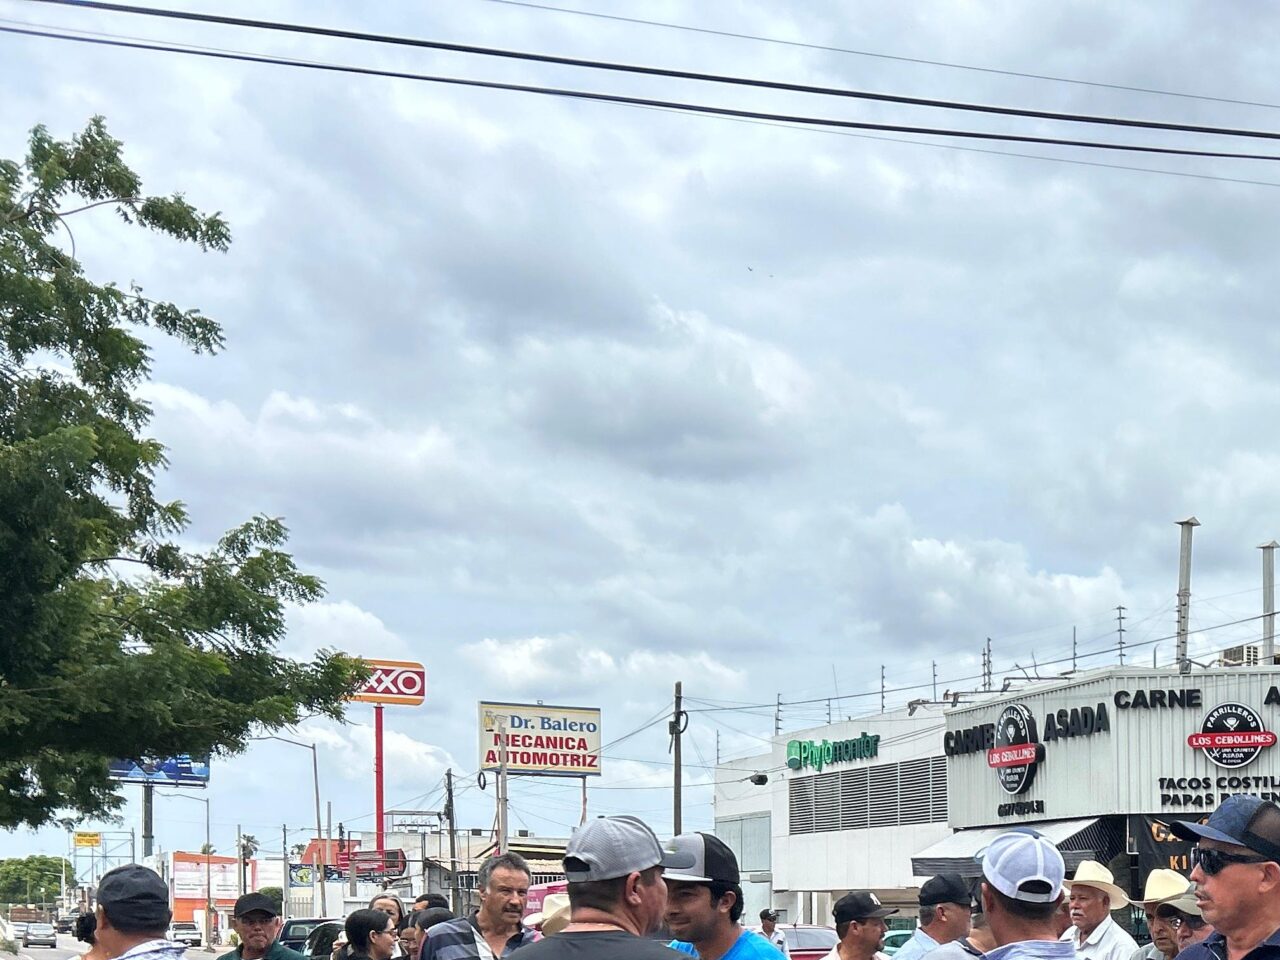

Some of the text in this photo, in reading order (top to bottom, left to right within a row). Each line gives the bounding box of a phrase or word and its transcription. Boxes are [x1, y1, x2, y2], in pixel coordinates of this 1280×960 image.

[356, 669, 422, 695] XXO
[1113, 689, 1203, 709] CARNE
[510, 715, 597, 732] Dr. Balero
[1206, 706, 1257, 728] PARRILLEROS
[944, 703, 1110, 757] CARNE ASADA
[493, 733, 588, 750] MECANICA
[1192, 734, 1272, 745] LOS CEBOLLINES
[485, 750, 598, 767] AUTOMOTRIZ
[989, 752, 1001, 765] LOS
[1158, 777, 1211, 790] TACOS
